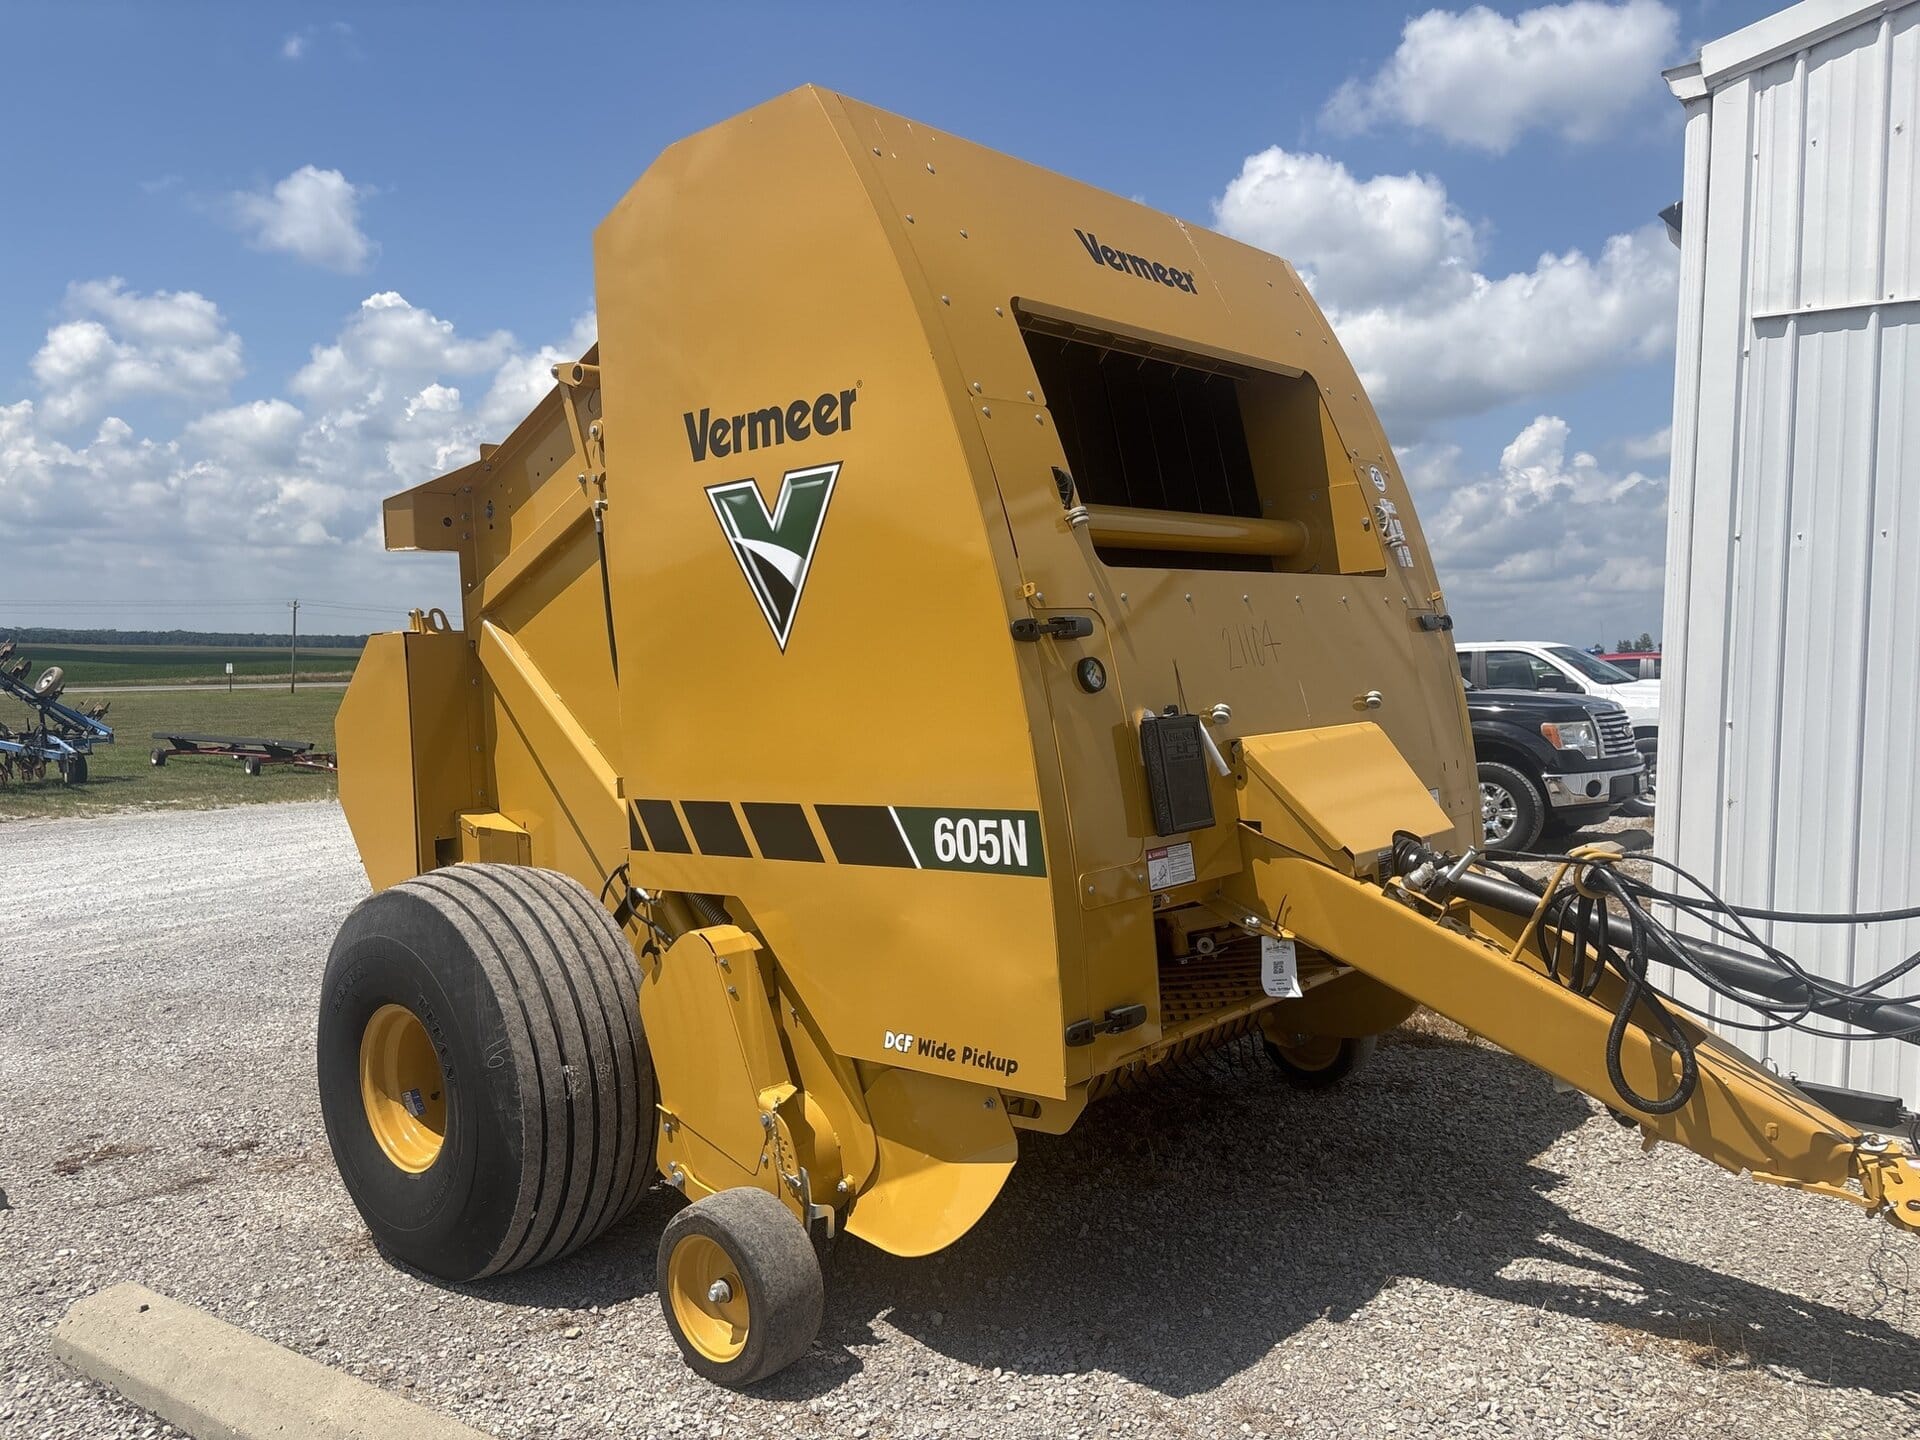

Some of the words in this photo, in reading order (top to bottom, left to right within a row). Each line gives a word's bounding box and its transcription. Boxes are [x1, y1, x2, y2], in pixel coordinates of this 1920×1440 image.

[1073, 228, 1198, 295] Vermeer
[683, 388, 857, 462] Vermeer
[933, 817, 1028, 867] 605N
[883, 1030, 914, 1053] DCF
[917, 1037, 957, 1062] Wide
[961, 1046, 1019, 1076] Pickup
